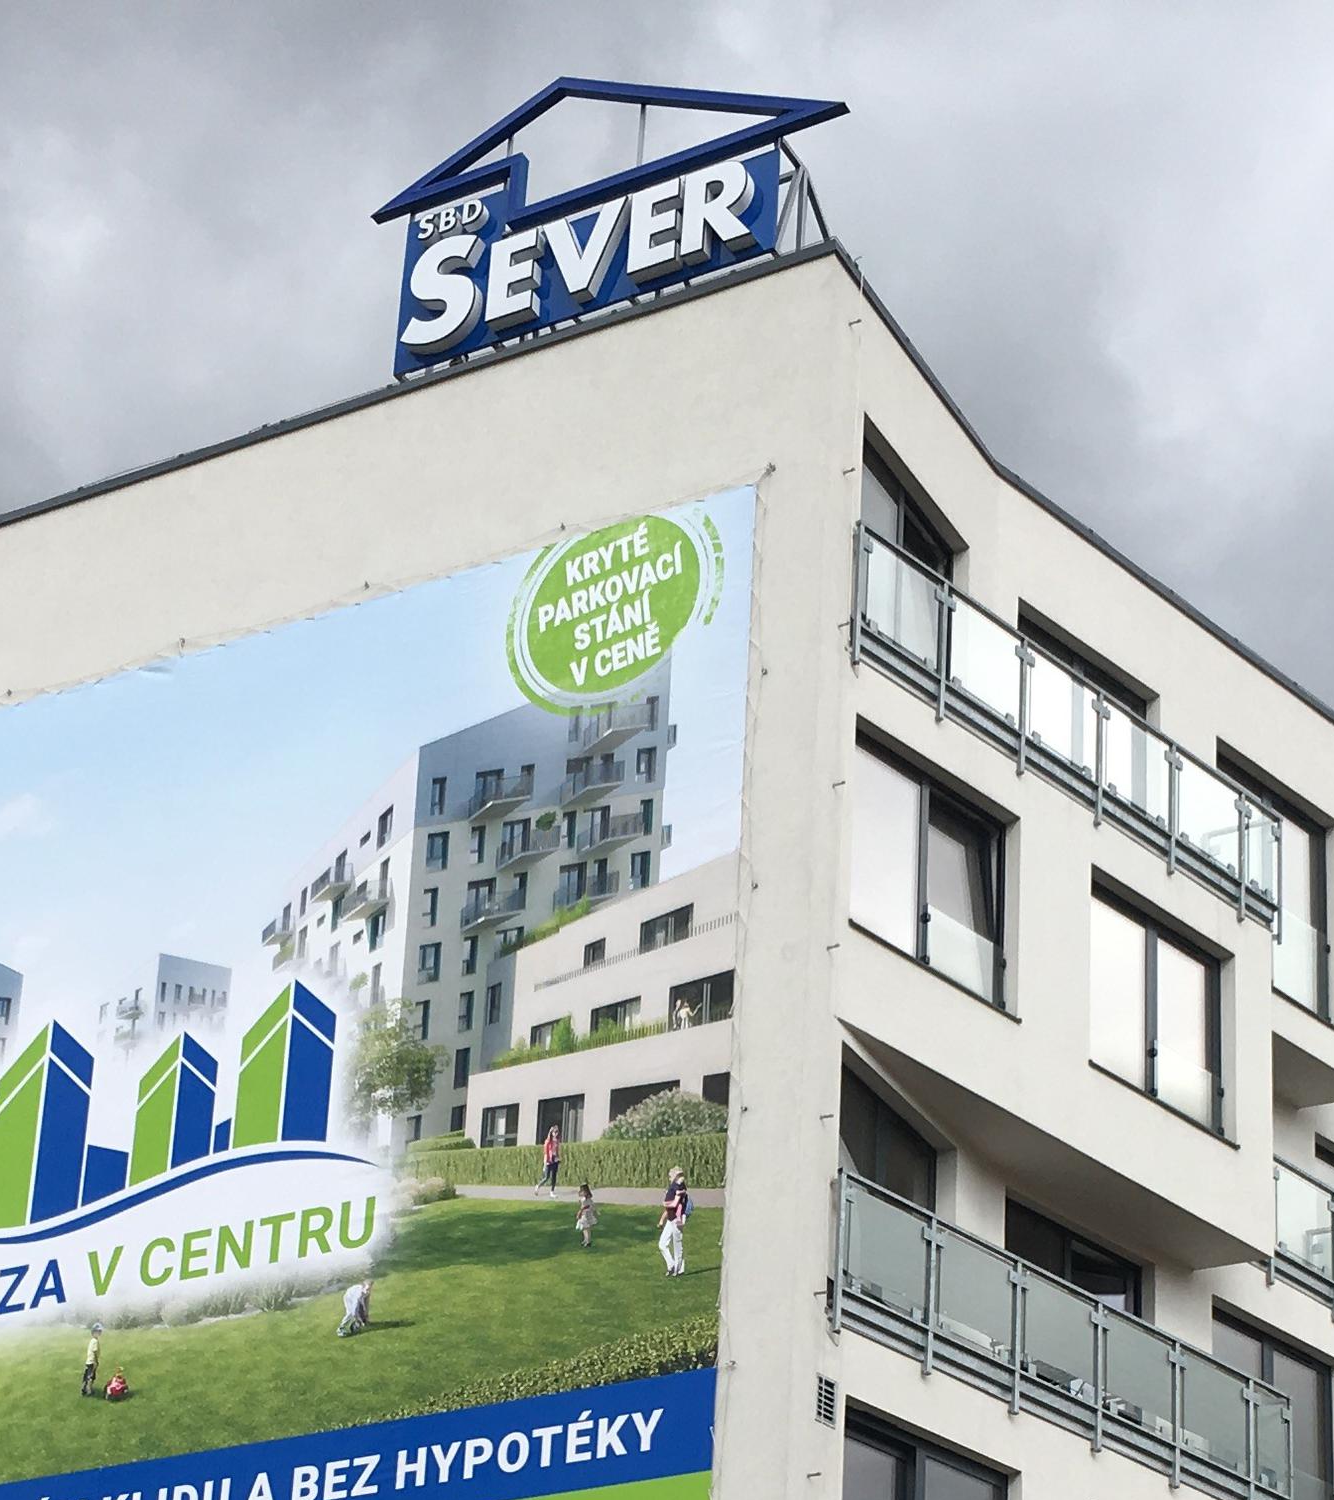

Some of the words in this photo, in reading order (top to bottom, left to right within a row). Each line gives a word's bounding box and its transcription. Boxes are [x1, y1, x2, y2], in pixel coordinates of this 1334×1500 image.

[399, 160, 753, 350] SEVER
[417, 199, 486, 241] SBD
[538, 541, 683, 633] PARKOVACÍ
[565, 522, 650, 587] KRYTÉ
[569, 656, 589, 687] V
[594, 620, 662, 677] CENĚ
[573, 588, 652, 651] STÁNÍ
[87, 1245, 124, 1297] V
[139, 1196, 377, 1287] CENTRU
[394, 1408, 664, 1490] HYPOTÉKY
